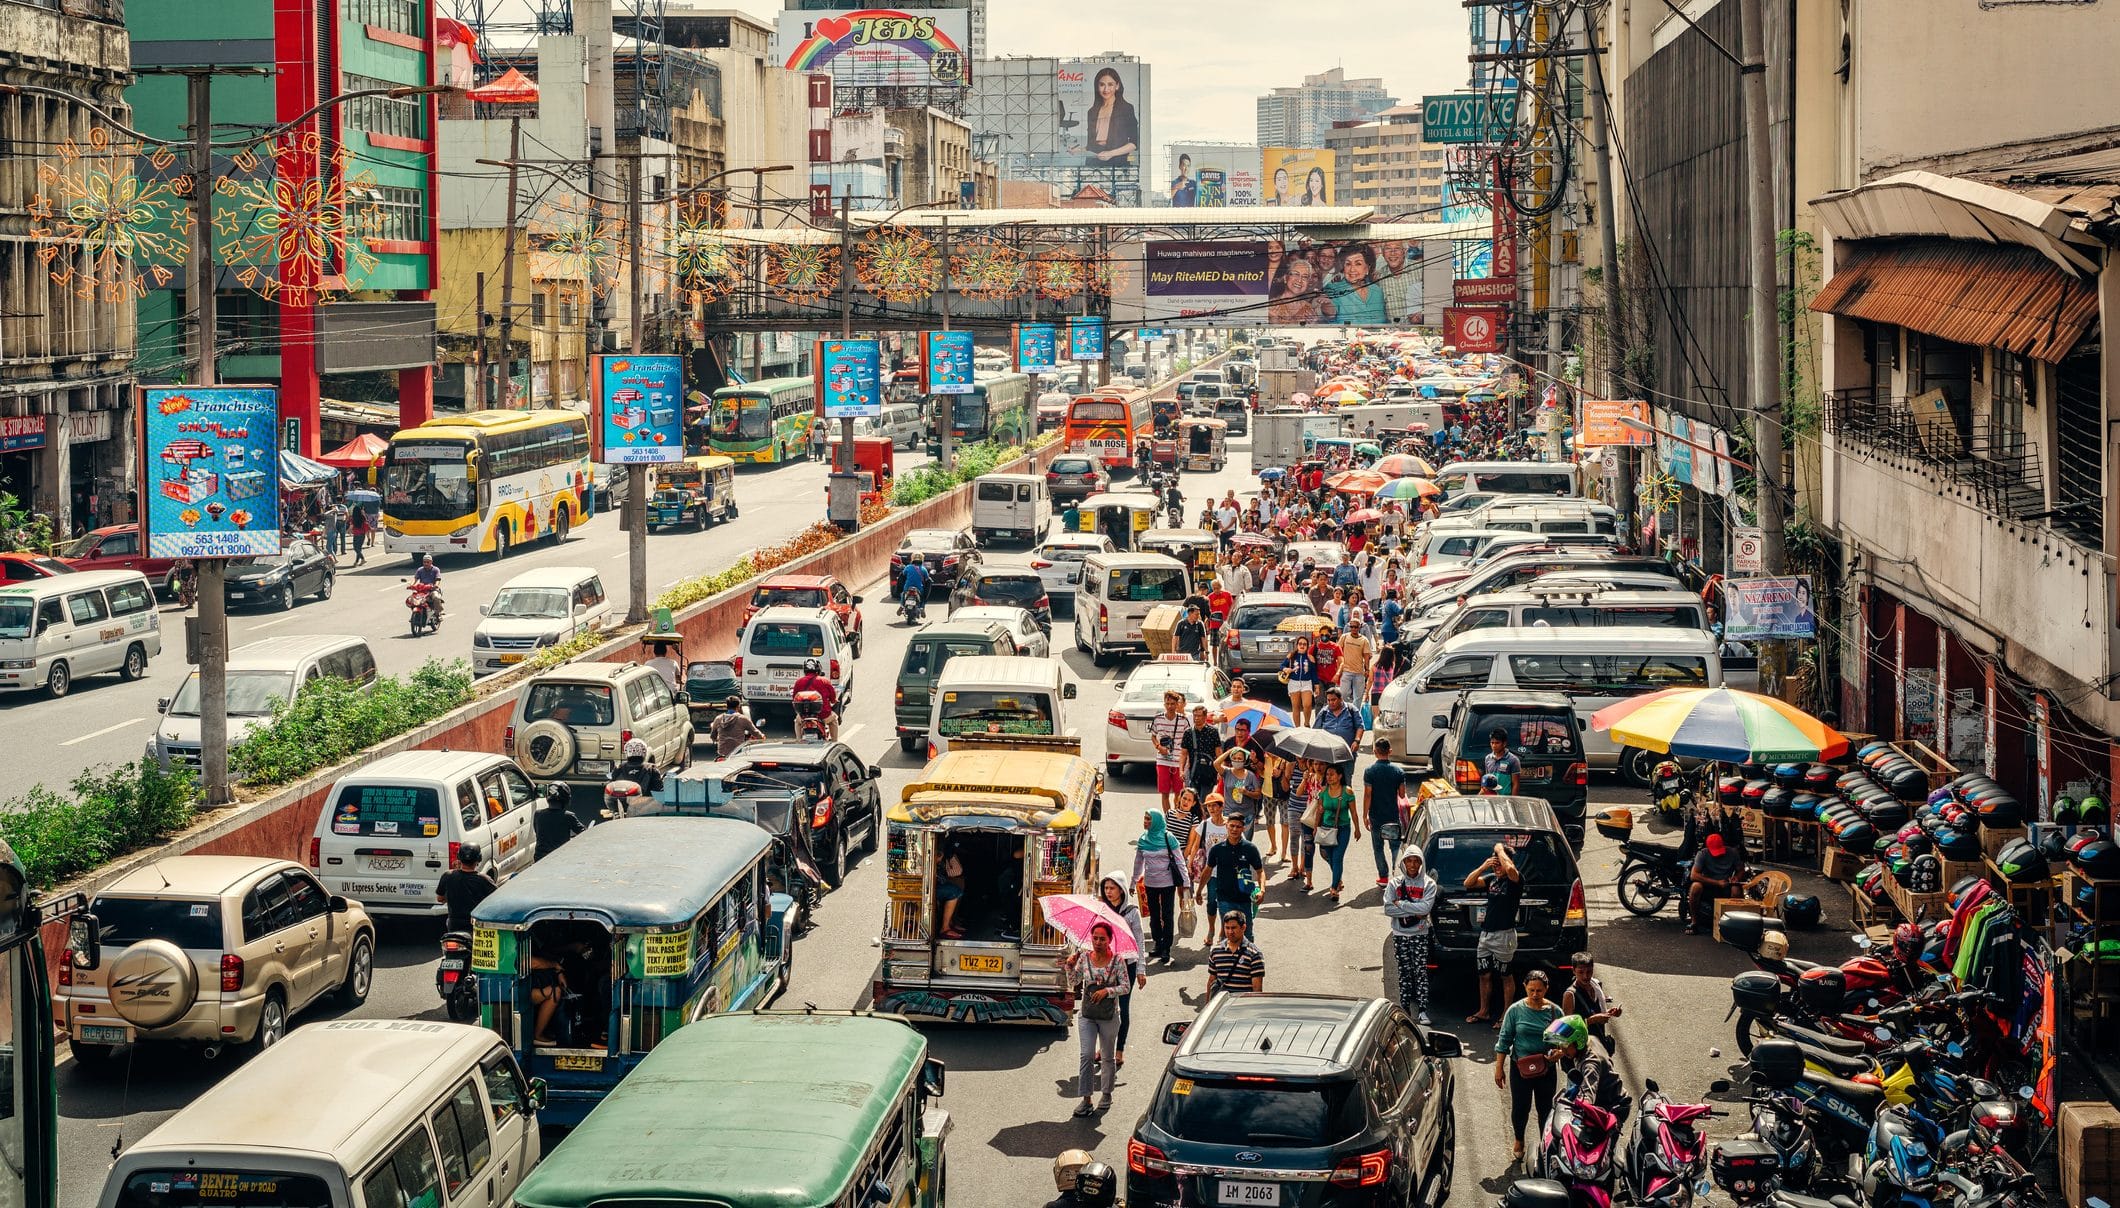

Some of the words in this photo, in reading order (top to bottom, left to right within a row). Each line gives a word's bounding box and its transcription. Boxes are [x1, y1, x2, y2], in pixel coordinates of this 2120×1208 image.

[804, 22, 813, 39] I
[853, 16, 935, 45] JED'S
[937, 59, 958, 72] 24
[1427, 129, 1454, 138] HOTEL
[1151, 272, 1173, 284] May
[1175, 272, 1220, 282] RiteMED
[1222, 271, 1235, 281] ba
[1238, 271, 1264, 281] nito?
[1456, 284, 1515, 296] PAWNSHOP
[194, 401, 261, 412] Franchise
[9, 418, 22, 435] STOP
[23, 416, 44, 434] BICYCLE
[69, 415, 98, 437] YCLIST
[196, 535, 213, 543] 563
[218, 534, 239, 543] 1408
[182, 546, 204, 555] 0927
[208, 546, 225, 555] 011
[228, 545, 251, 554] 8000
[1744, 591, 1792, 604] NAZARENO
[954, 784, 992, 792] ANTONIO
[993, 786, 1032, 794] SPURS
[342, 882, 350, 891] UV
[352, 882, 374, 894] Express
[376, 883, 396, 893] Service
[665, 935, 677, 943] 24/7
[648, 956, 660, 964] TEXT
[965, 957, 979, 967] TWZ
[985, 959, 999, 968] 122
[884, 991, 1069, 1025] ARTHUR
[84, 1028, 100, 1037] RCR
[1241, 1152, 1257, 1161] Ford
[185, 1173, 198, 1182] 24
[200, 1174, 238, 1190] BENTE
[239, 1182, 248, 1192] ON
[199, 1190, 237, 1198] QUATRO
[1246, 1186, 1272, 1200] 2063
